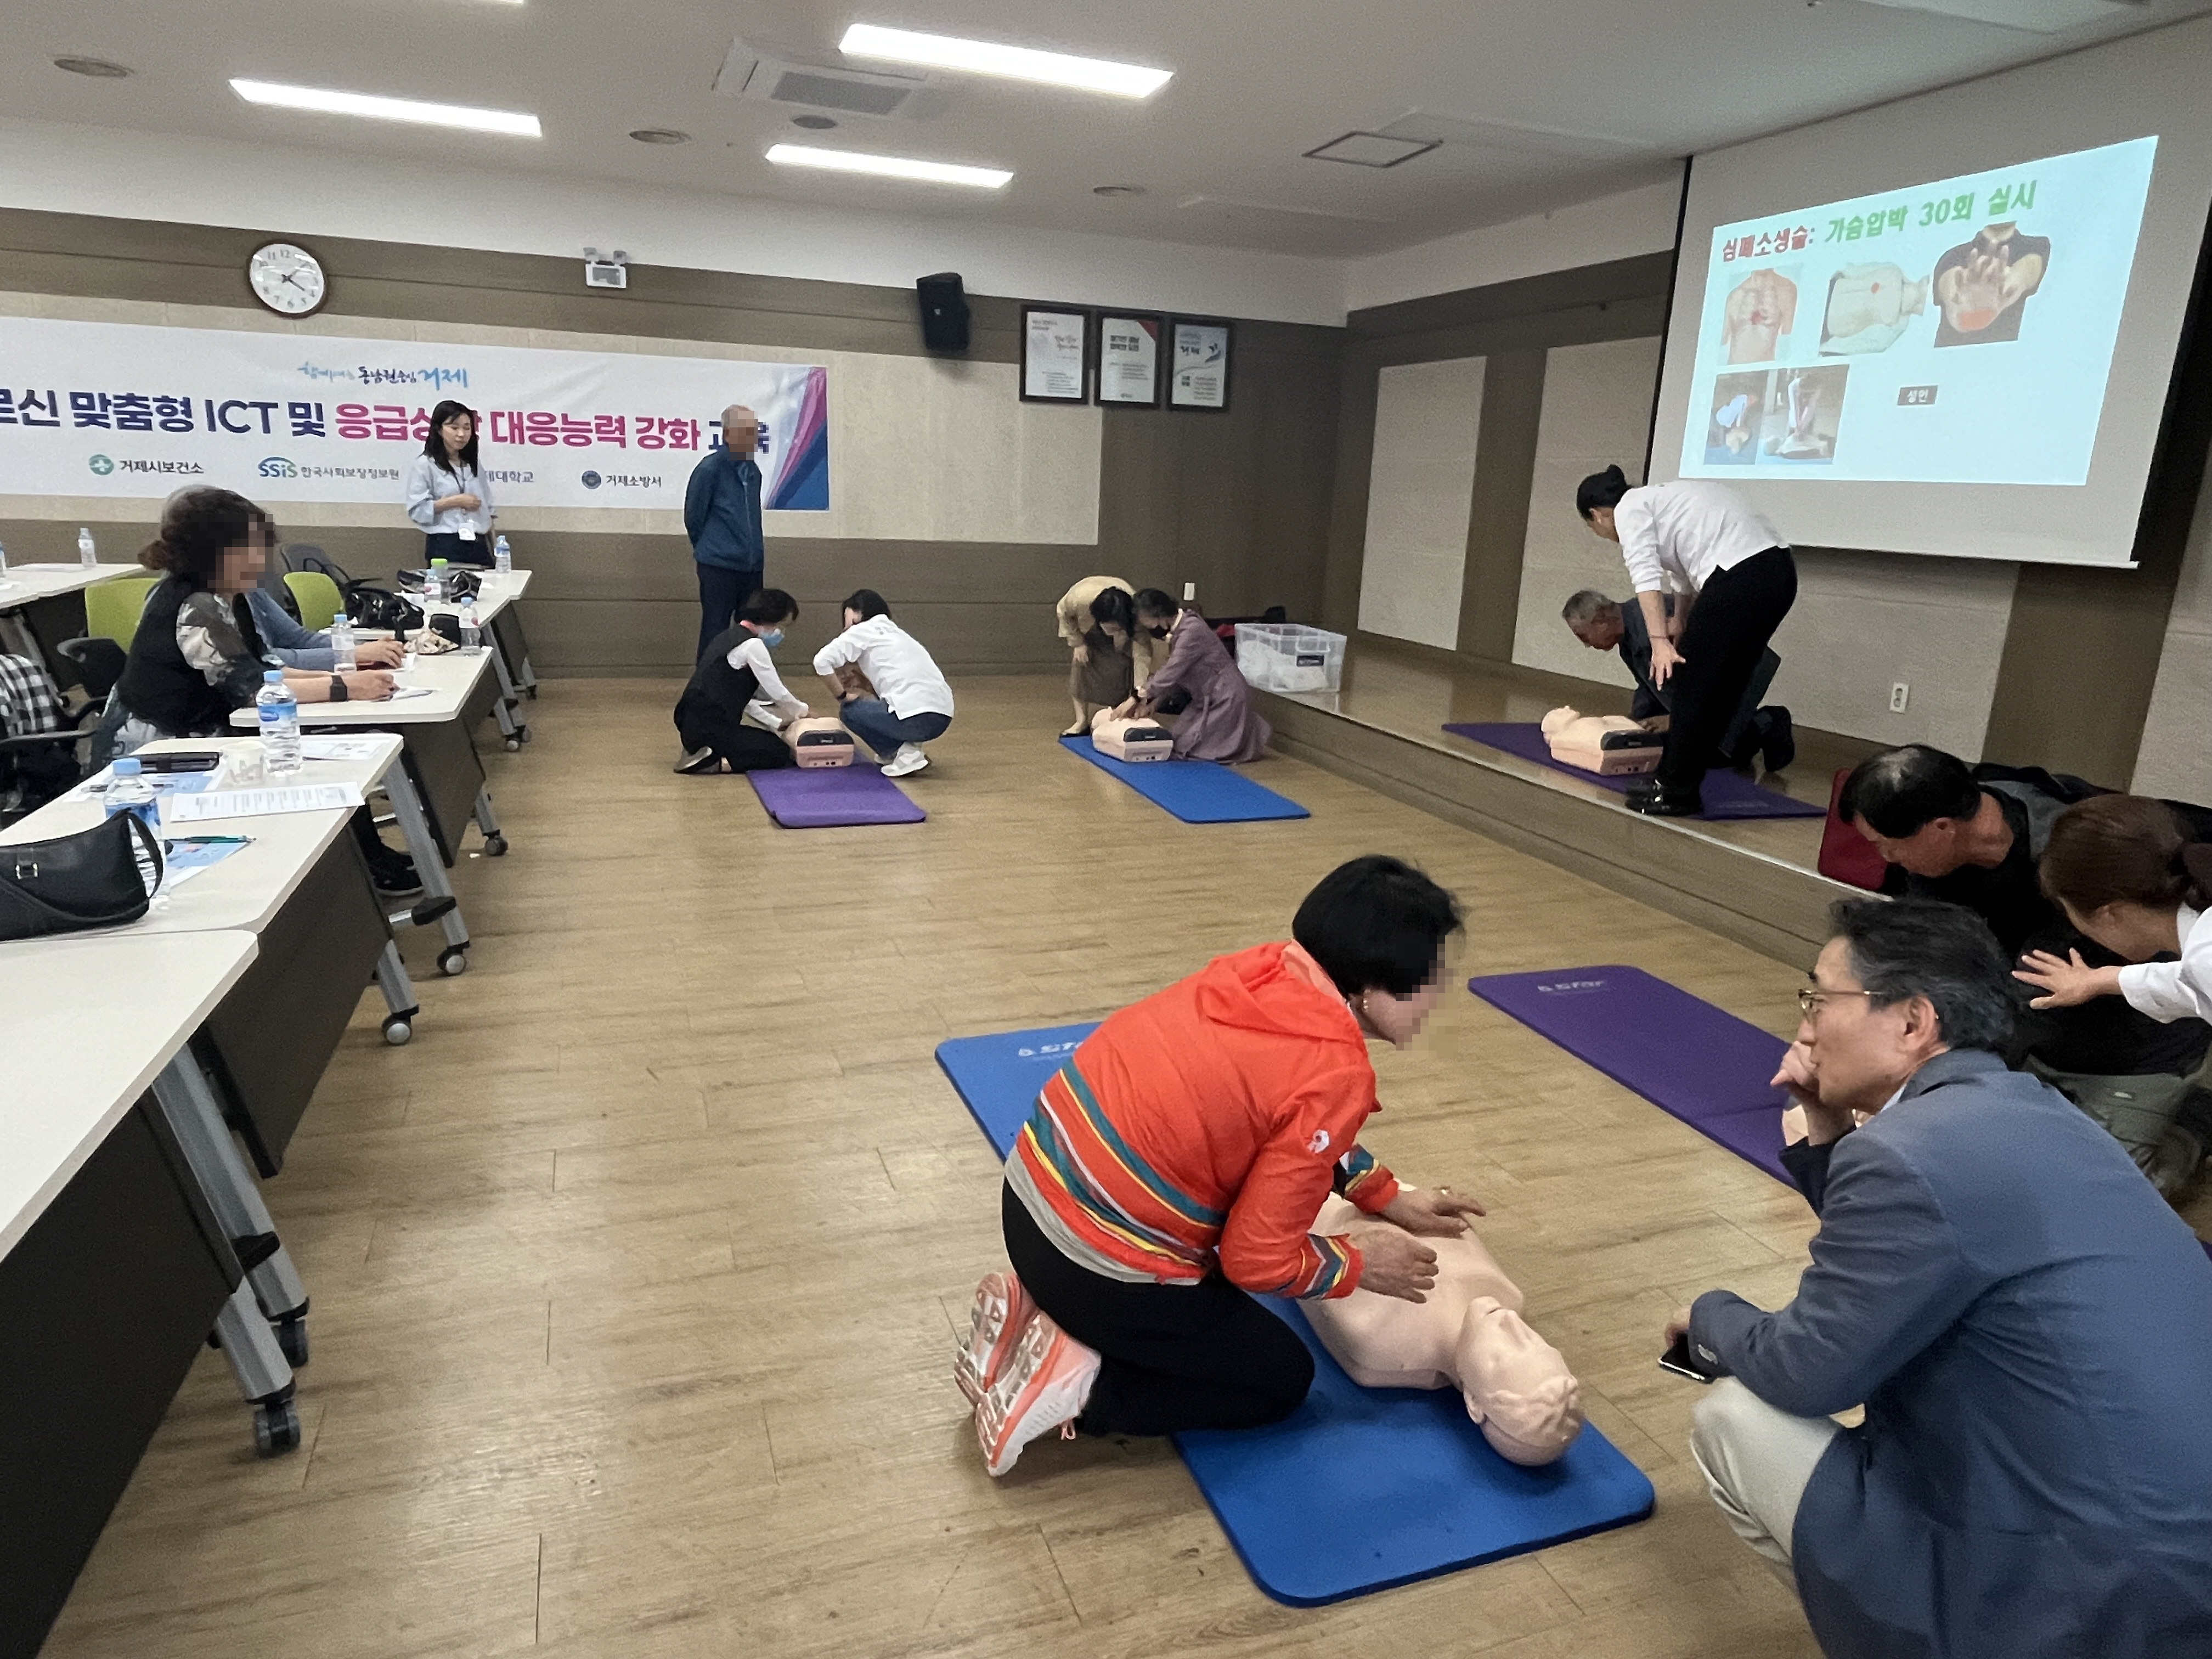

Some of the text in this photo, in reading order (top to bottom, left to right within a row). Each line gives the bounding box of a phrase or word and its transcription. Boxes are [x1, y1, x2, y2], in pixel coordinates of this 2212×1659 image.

[1825, 205, 1908, 242] 가슴압박
[1918, 192, 1975, 226] 30회
[1988, 179, 2037, 216] 실시
[418, 368, 469, 391] 거제
[69, 392, 194, 432] 맞춤형
[205, 399, 279, 434] ICT
[287, 402, 326, 437] 및
[335, 403, 483, 441] 응급
[490, 411, 627, 449] 대응능력
[635, 416, 701, 451] 강화
[119, 460, 204, 474] 거제시보건소
[606, 475, 661, 488] 거제소방서
